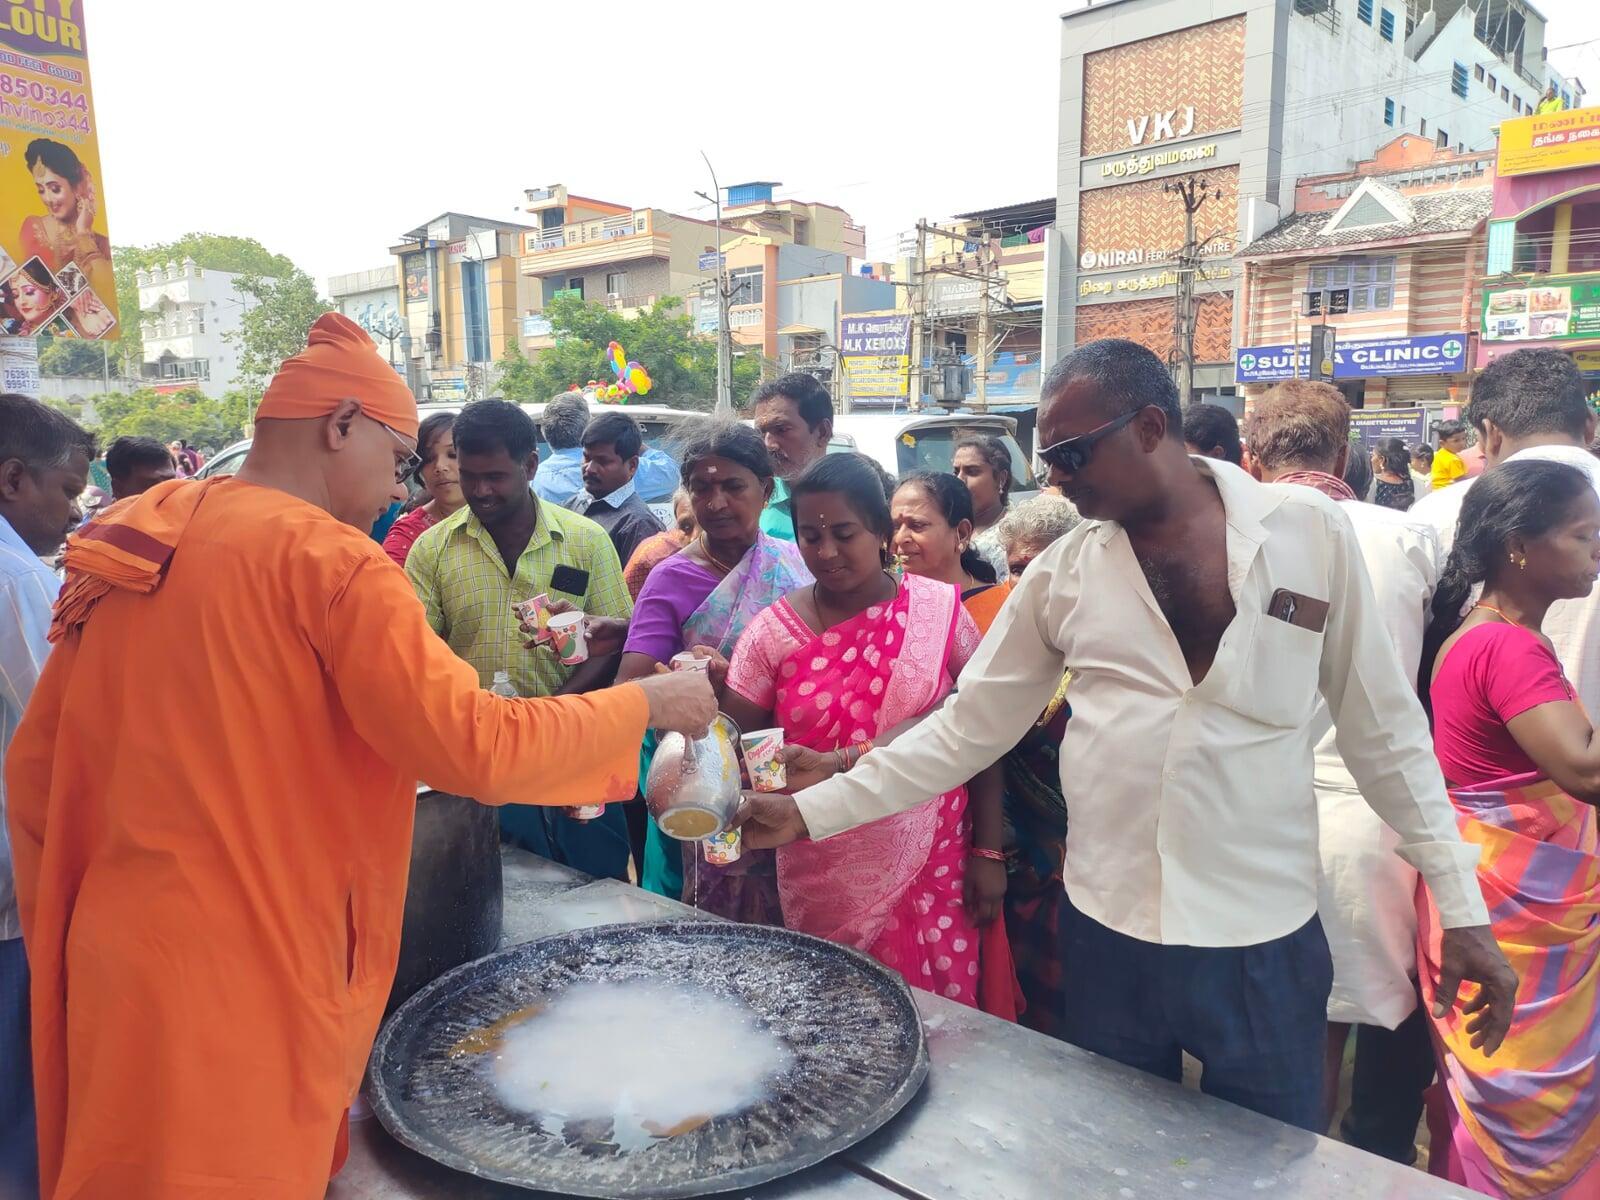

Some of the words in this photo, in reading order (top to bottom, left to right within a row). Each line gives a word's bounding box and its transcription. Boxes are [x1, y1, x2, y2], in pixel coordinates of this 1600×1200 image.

[0, 73, 88, 113] 850344
[1127, 106, 1196, 146] VKJ
[1101, 143, 1217, 178] மருத்துவமனை
[1097, 248, 1144, 268] NIRAI
[1080, 278, 1114, 298] நிறை
[1351, 345, 1440, 363] CLINIC
